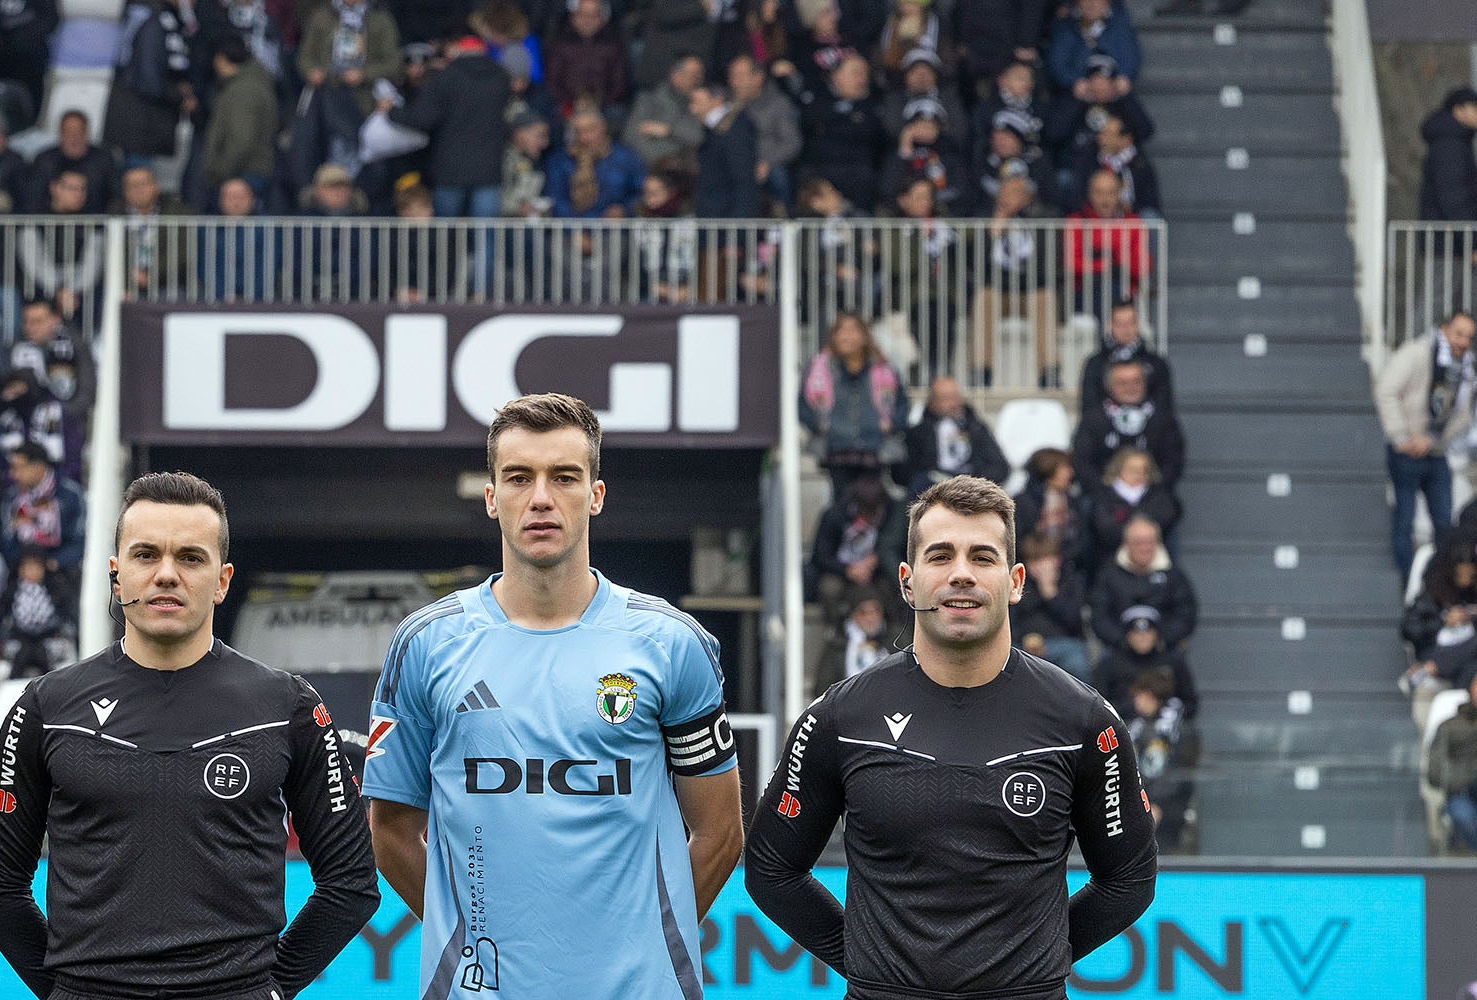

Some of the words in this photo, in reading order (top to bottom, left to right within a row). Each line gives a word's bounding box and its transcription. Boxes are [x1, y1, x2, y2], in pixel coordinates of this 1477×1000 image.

[164, 313, 740, 433] DIGI
[0, 705, 27, 786] WÜRTH
[324, 728, 347, 813] WÜRTH
[463, 757, 632, 796] DIGI
[786, 713, 818, 792] WÜRTH
[1104, 753, 1124, 838] WÜRTH
[468, 846, 476, 877] 2031
[474, 826, 486, 932] RENACIMIENTO
[470, 885, 478, 931] Burgos
